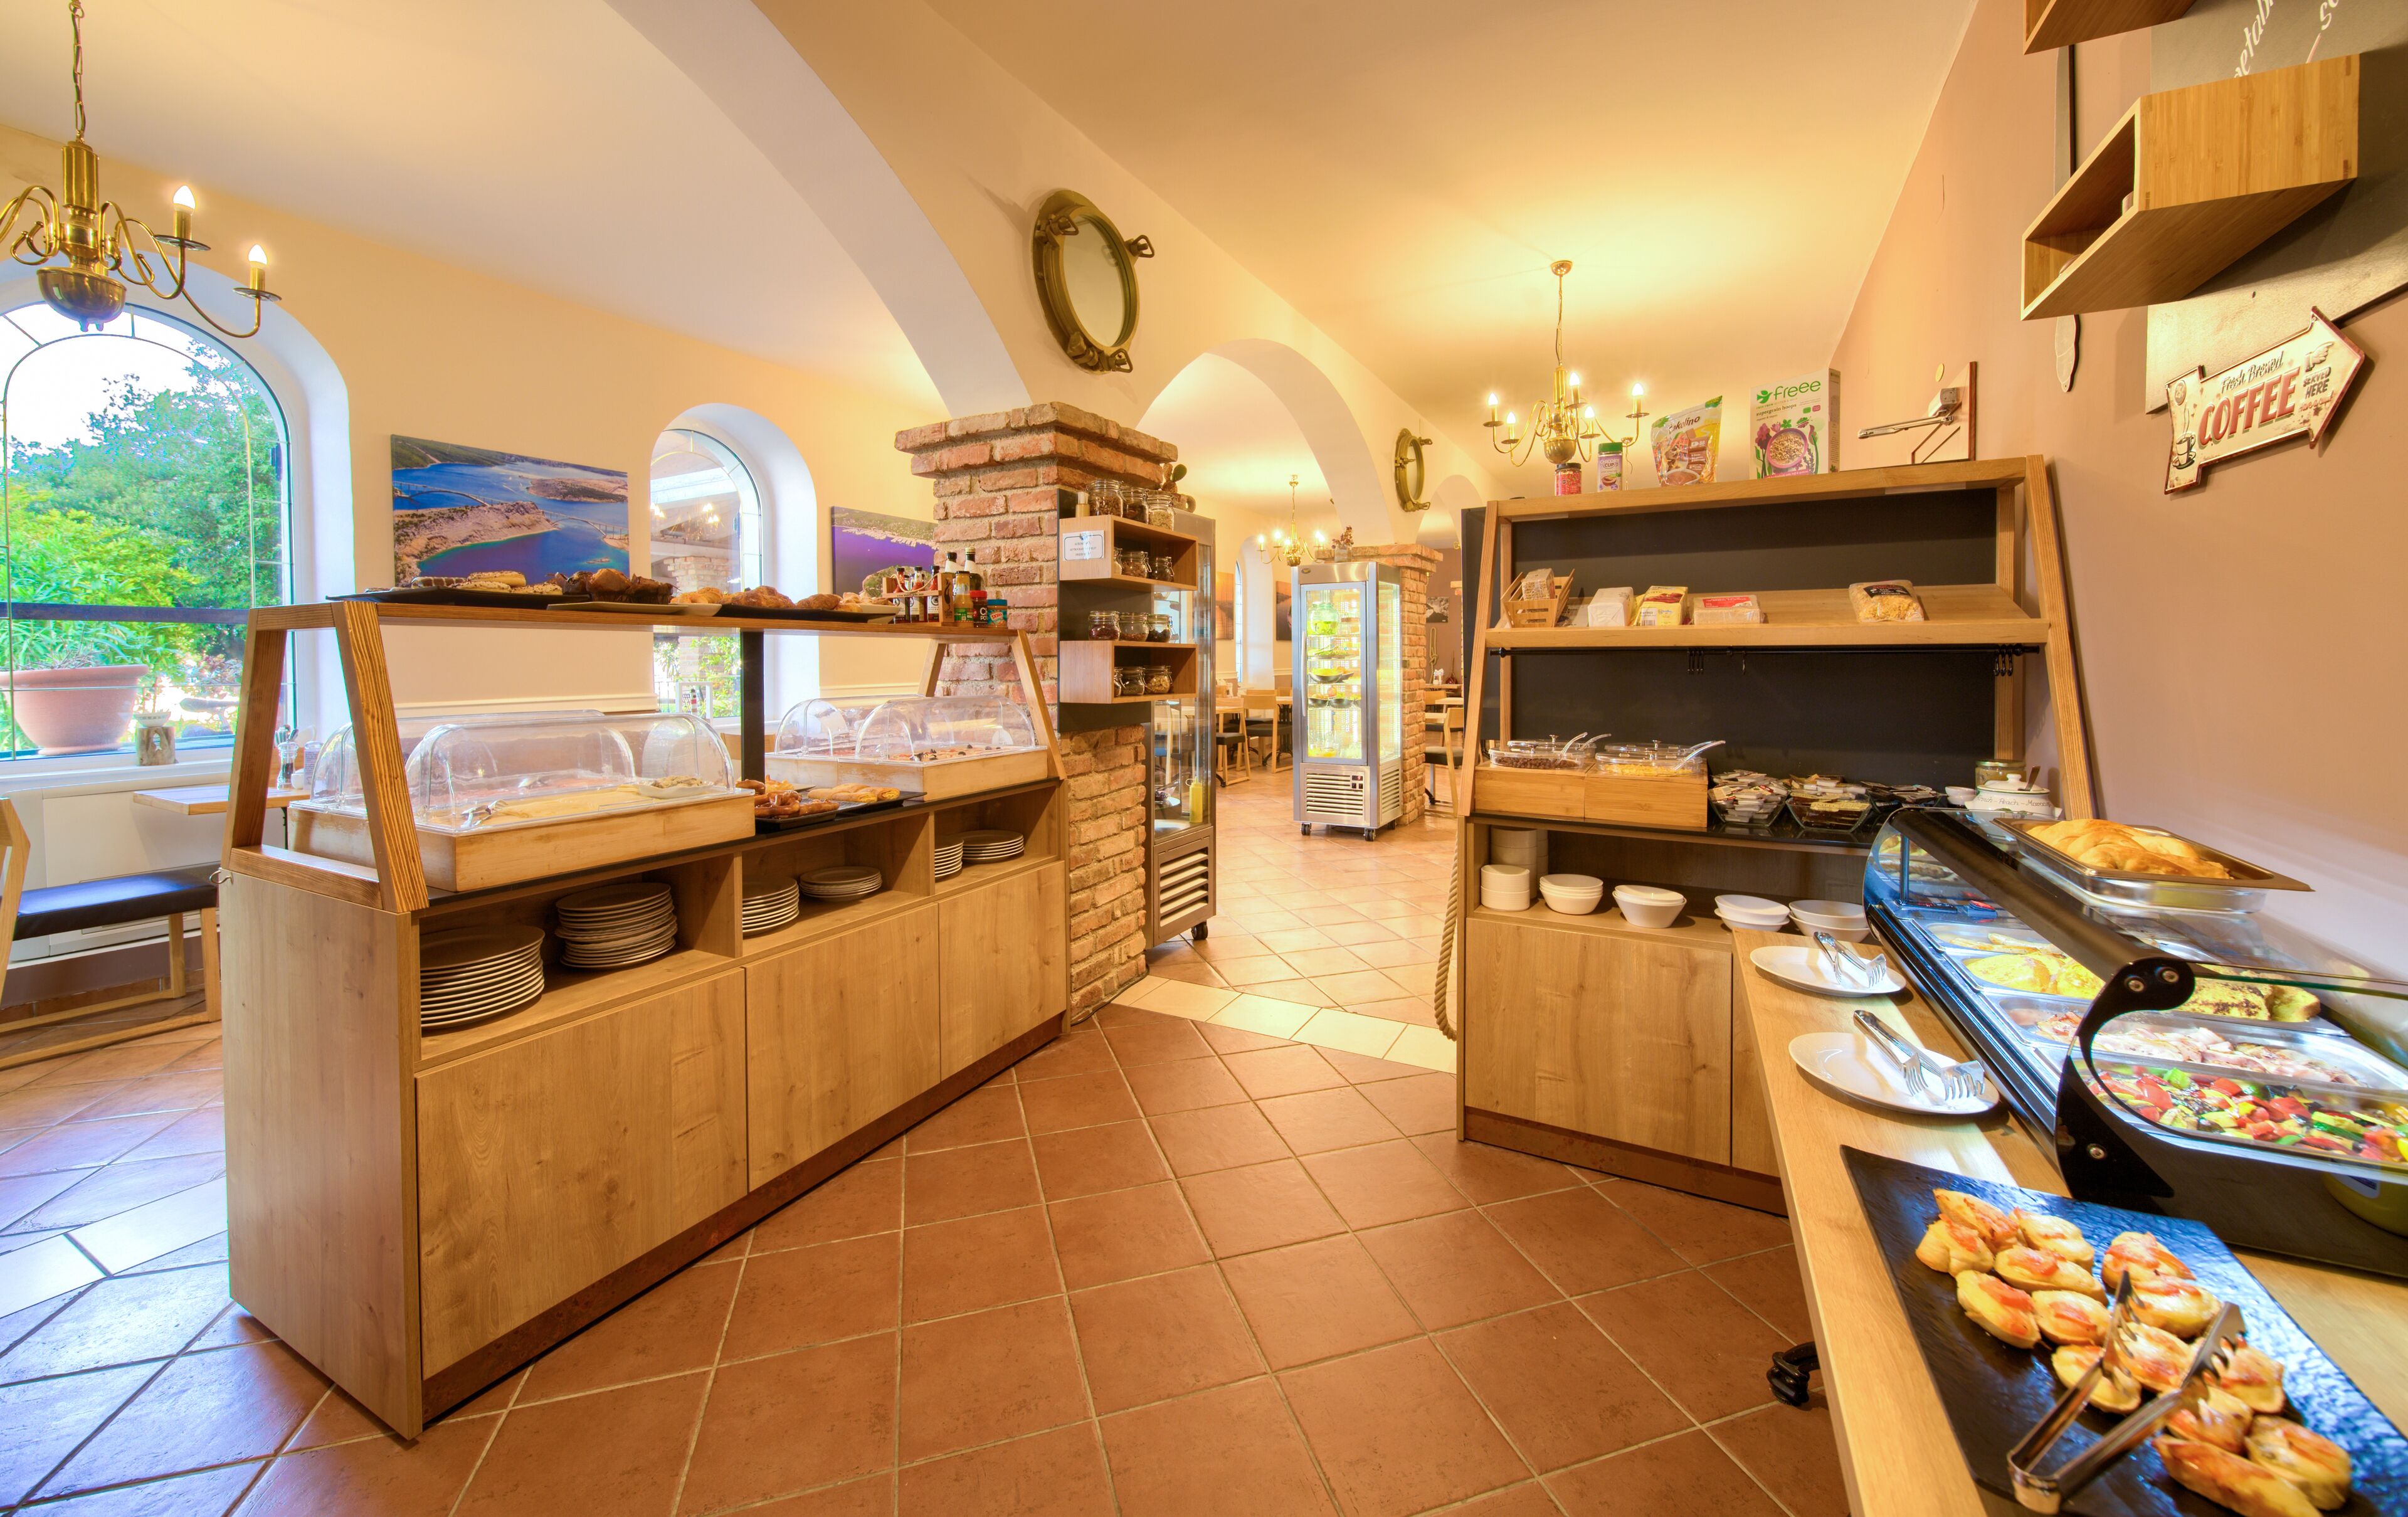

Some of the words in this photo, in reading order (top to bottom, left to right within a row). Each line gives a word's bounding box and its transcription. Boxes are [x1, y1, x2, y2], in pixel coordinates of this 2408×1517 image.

[2221, 369, 2246, 394] Fresh
[2248, 350, 2284, 383] Brewed
[1773, 381, 1821, 400] freee
[2305, 378, 2330, 399] HERE
[1756, 406, 1782, 417] supergrain
[1782, 404, 1797, 412] hoops
[2198, 366, 2301, 449] COFFEE
